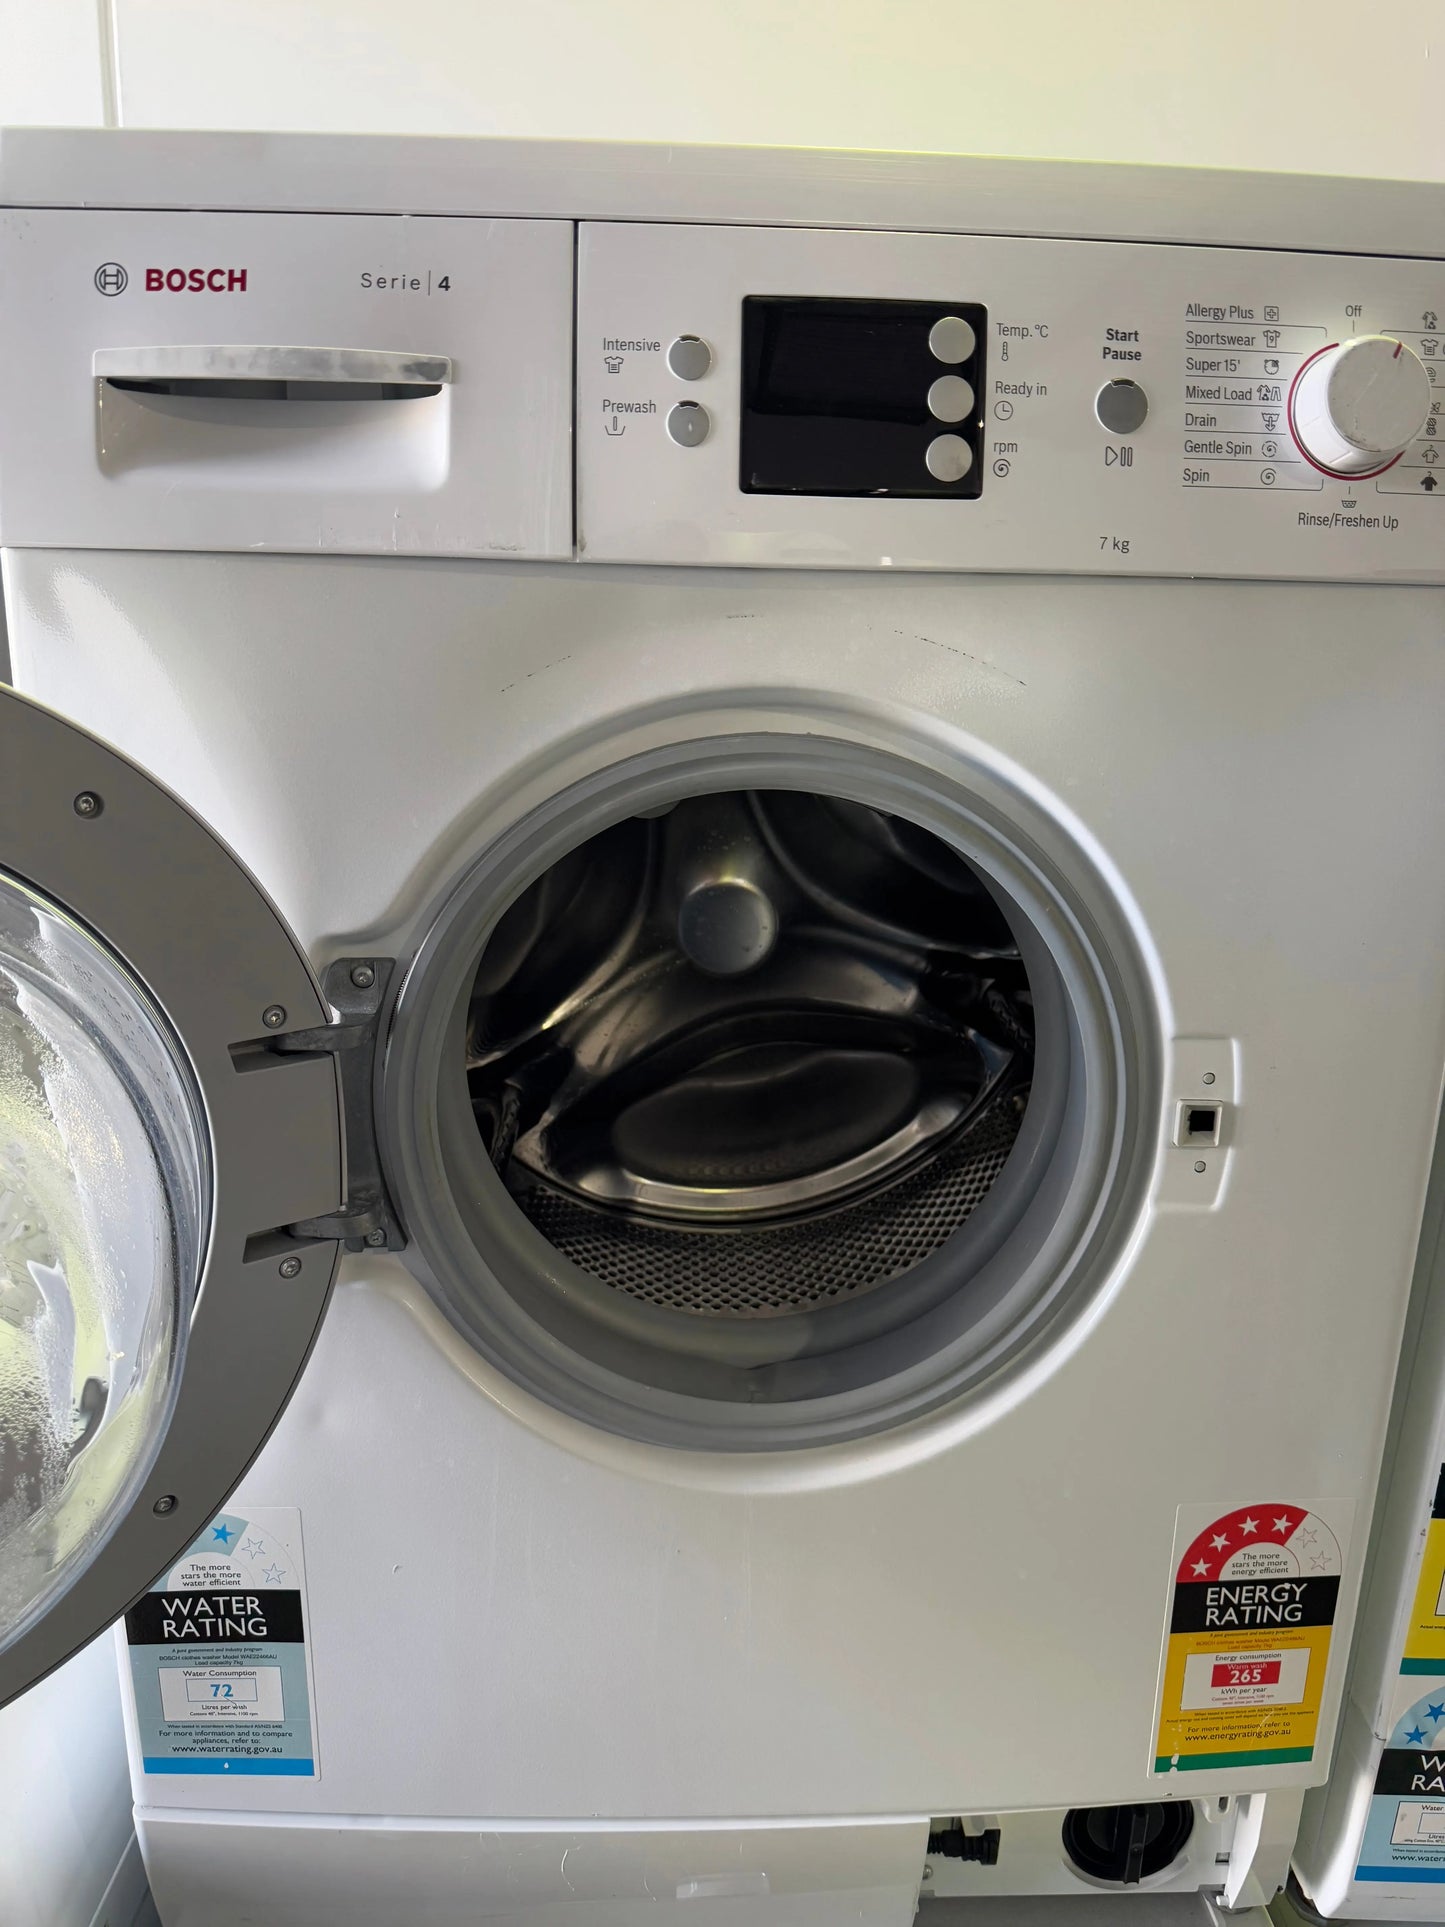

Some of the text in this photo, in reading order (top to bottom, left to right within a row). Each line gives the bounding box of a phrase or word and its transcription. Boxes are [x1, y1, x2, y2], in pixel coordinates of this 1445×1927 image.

[145, 268, 248, 292] BOSCH
[361, 272, 451, 291] Serie 4
[1185, 303, 1254, 320] Allergy Plus
[1345, 304, 1363, 317] Off
[996, 322, 1049, 340] Temp. °C
[1105, 328, 1139, 342] Start
[1186, 330, 1256, 346] Sportswear
[603, 337, 661, 351] Intensive
[1102, 347, 1142, 361] Pause
[1186, 357, 1241, 373] Super 15'
[995, 381, 1047, 398] Ready in
[1185, 385, 1252, 400] Mixed Load
[602, 399, 657, 413] Prewash
[1185, 412, 1217, 427] Drain
[993, 442, 1018, 455] rpm
[1184, 439, 1252, 457] Gentle Spin
[1183, 468, 1210, 484] Spin
[1298, 512, 1399, 531] Rinse/Freshen Up
[1100, 536, 1130, 553] 7 kg
[1206, 1583, 1308, 1606] ENERGY
[161, 1596, 263, 1616] WATER
[1205, 1603, 1303, 1626] RATING
[163, 1617, 268, 1638] RATING
[209, 1669, 257, 1677] Consumption
[1230, 1669, 1262, 1684] 265
[210, 1684, 234, 1698] 72
[1185, 1730, 1291, 1741] www.energyrating.gov.au
[172, 1745, 283, 1754] www.waterrating.gov.au
